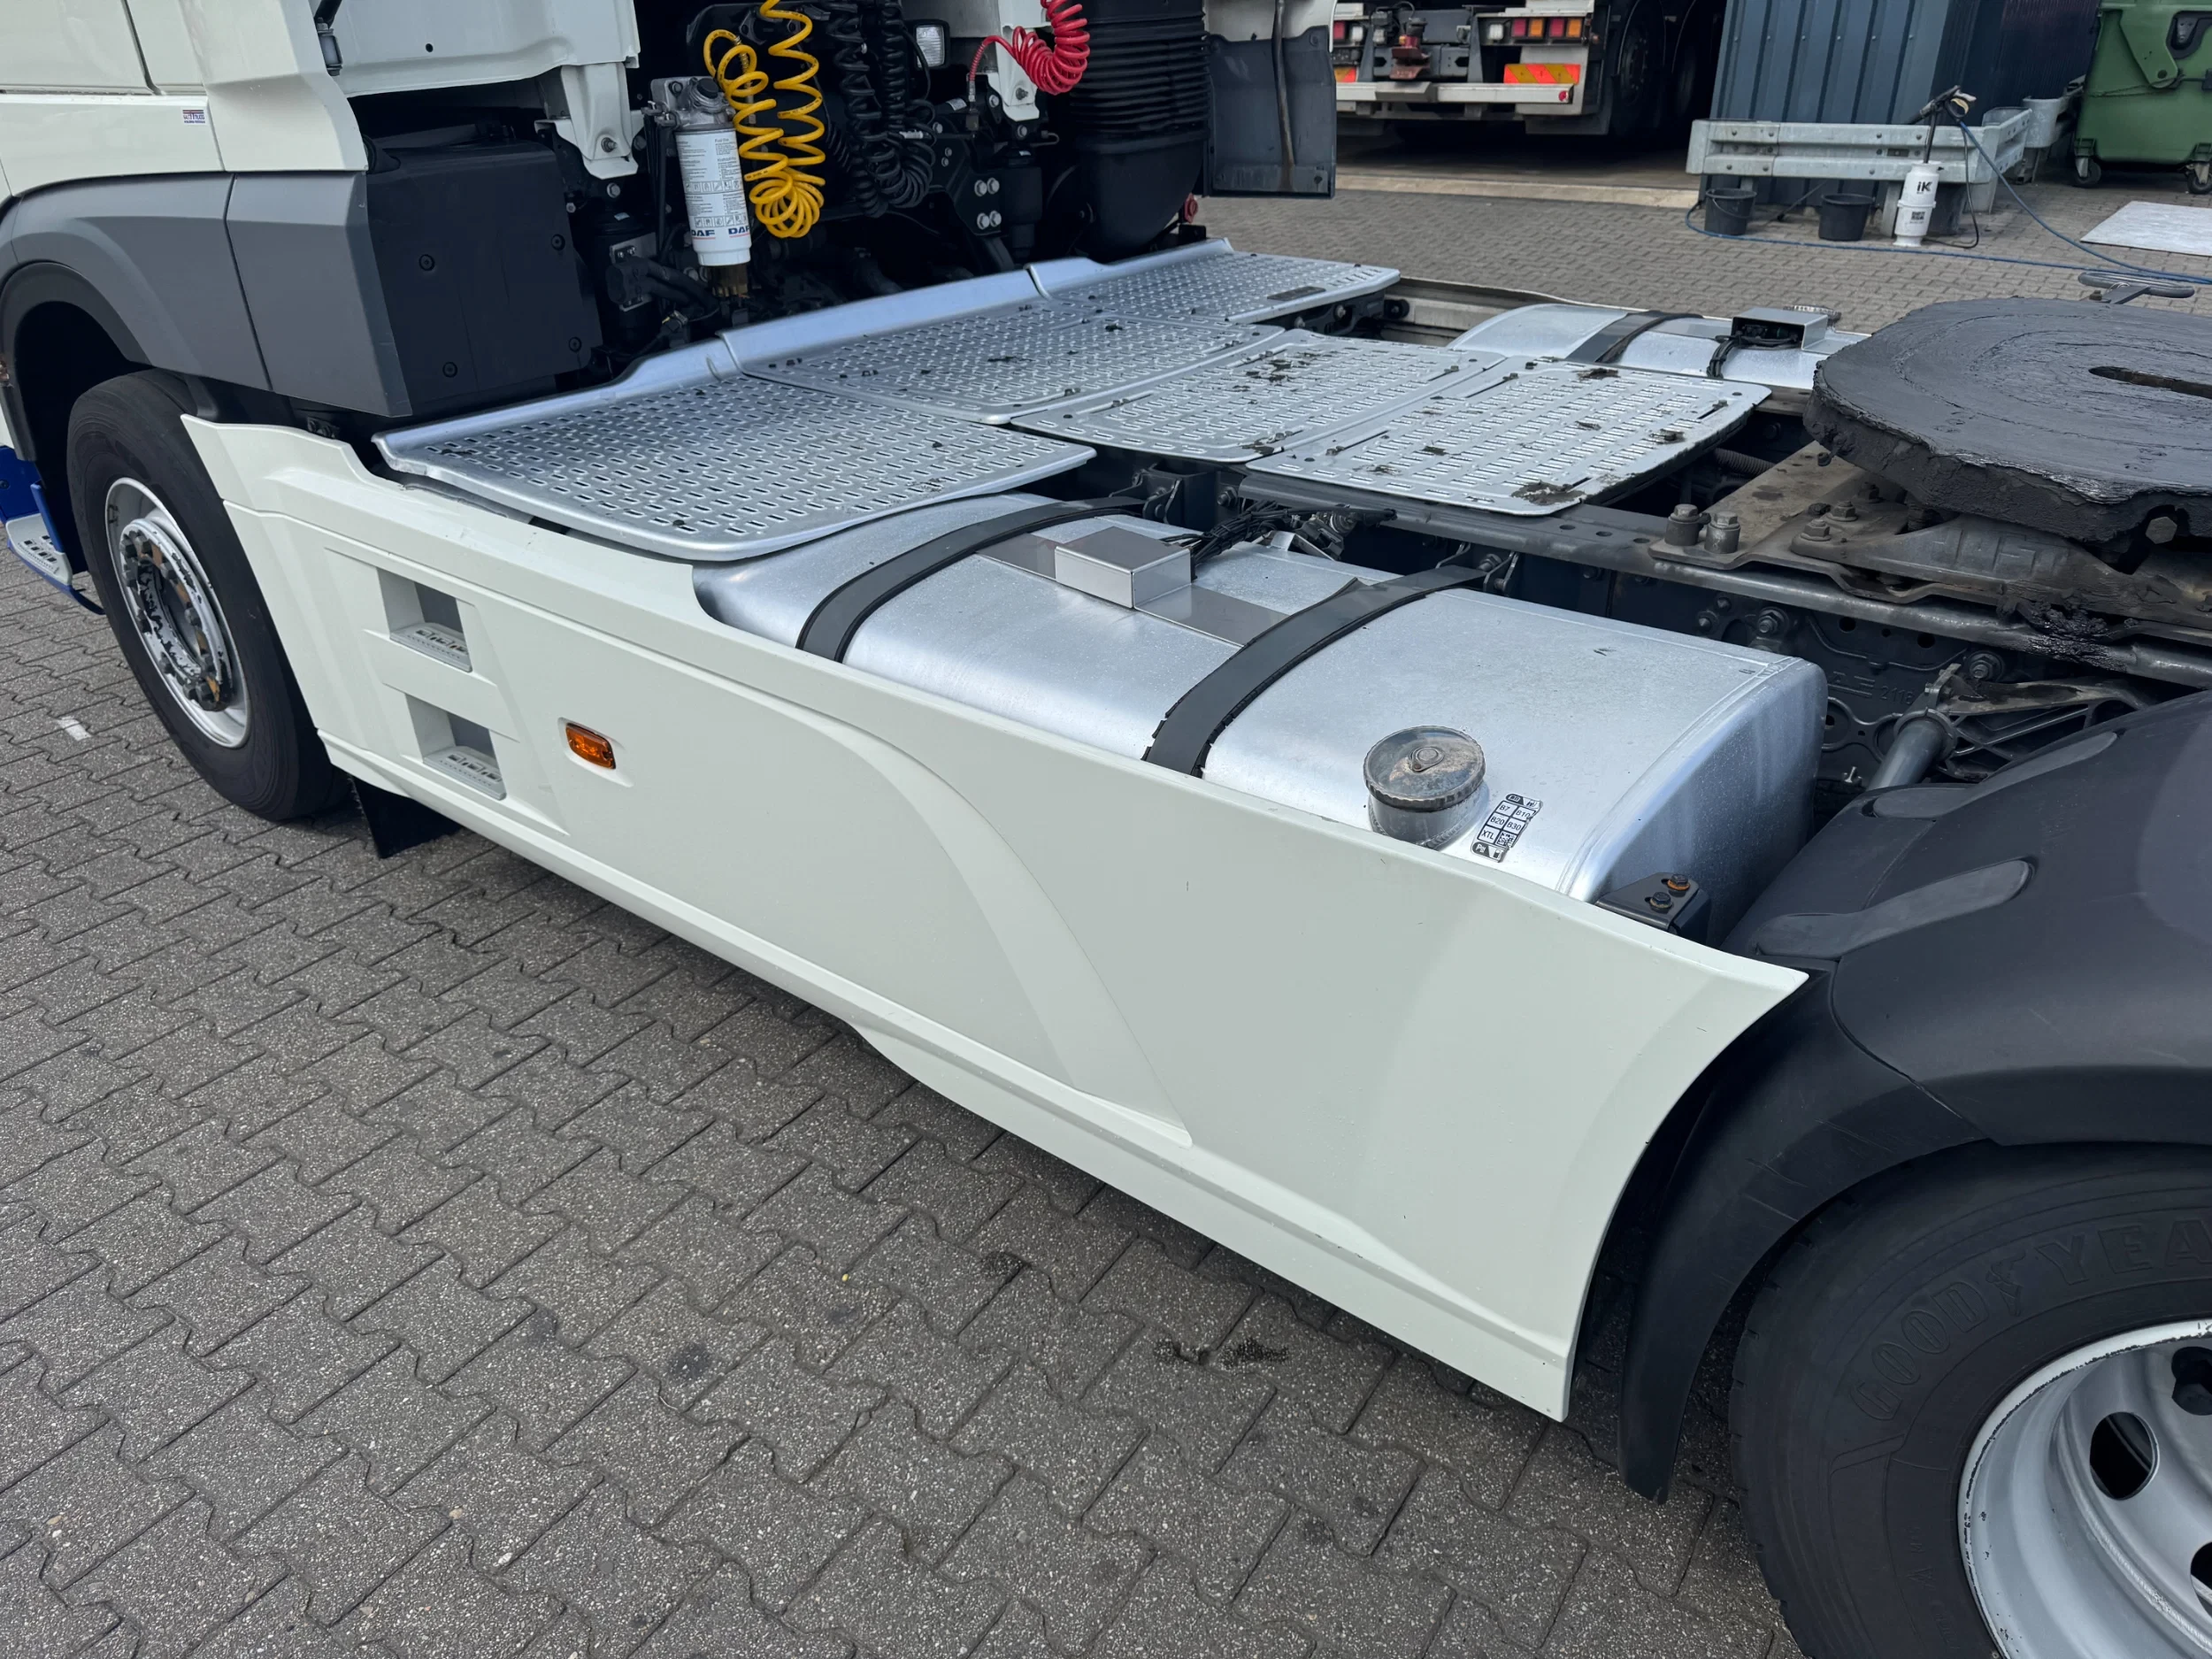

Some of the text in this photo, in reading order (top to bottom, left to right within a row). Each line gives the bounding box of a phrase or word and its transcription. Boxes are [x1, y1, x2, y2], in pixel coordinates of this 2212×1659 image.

[1515, 810, 1531, 818] B10
[1490, 816, 1522, 831] B20 B30
[1481, 829, 1495, 841] XTL
